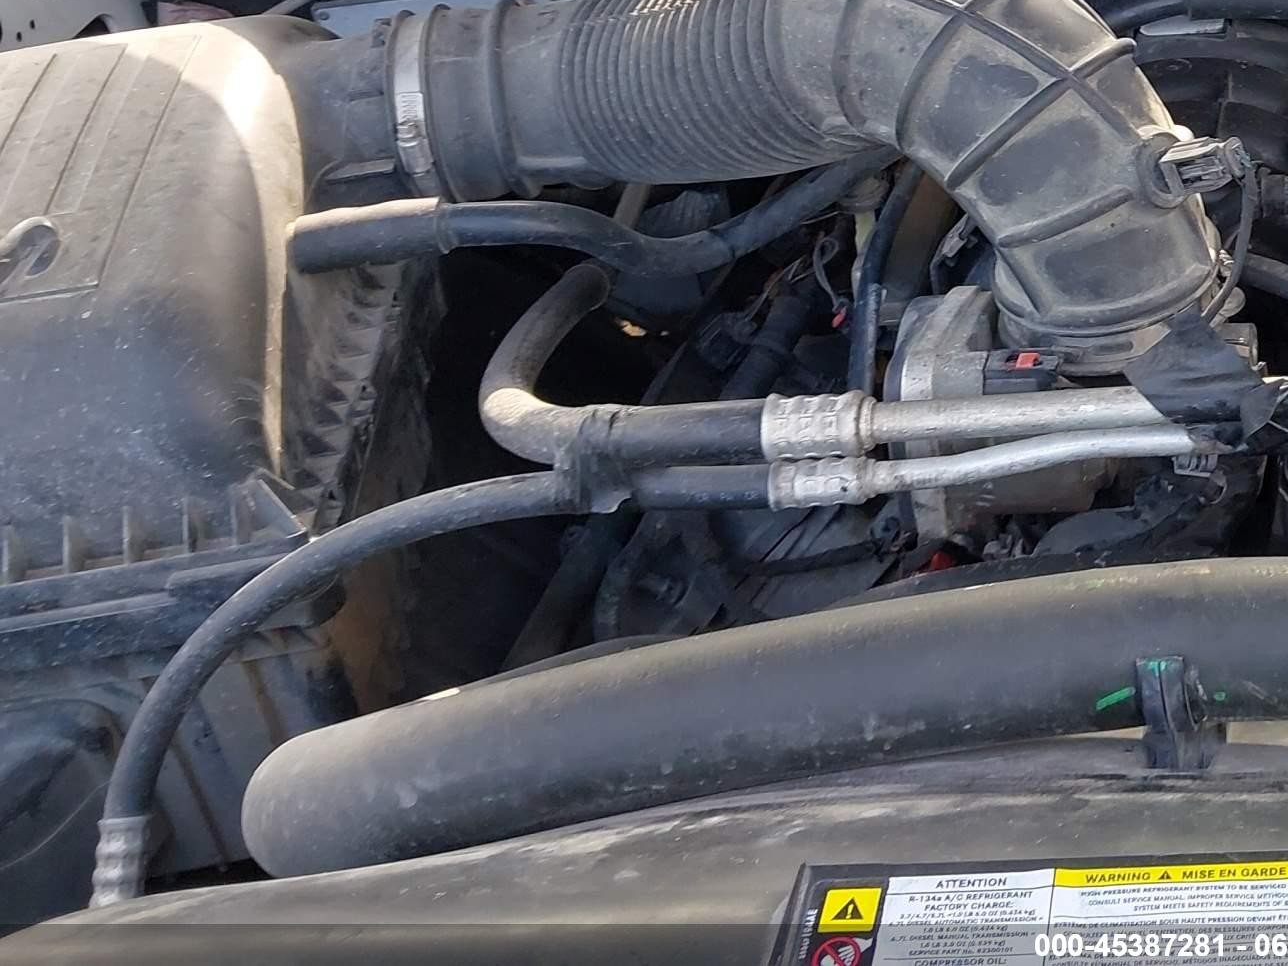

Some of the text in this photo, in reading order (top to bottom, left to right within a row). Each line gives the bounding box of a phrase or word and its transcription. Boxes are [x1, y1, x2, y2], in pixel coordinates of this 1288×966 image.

[1085, 872, 1151, 883] WARNING
[1182, 869, 1215, 879] MISE
[1219, 868, 1236, 877] EN
[1241, 867, 1286, 877] GARDE
[936, 877, 1007, 888] ATTENTION
[944, 894, 963, 902] A/C
[966, 891, 1033, 900] REFRIGERANT
[1088, 898, 1120, 906] CONSULT
[924, 901, 1014, 912] FACTORY CHARGE:
[1100, 920, 1157, 928] CLIMATISATION
[914, 957, 1007, 966] COMPRESSOR OIL:
